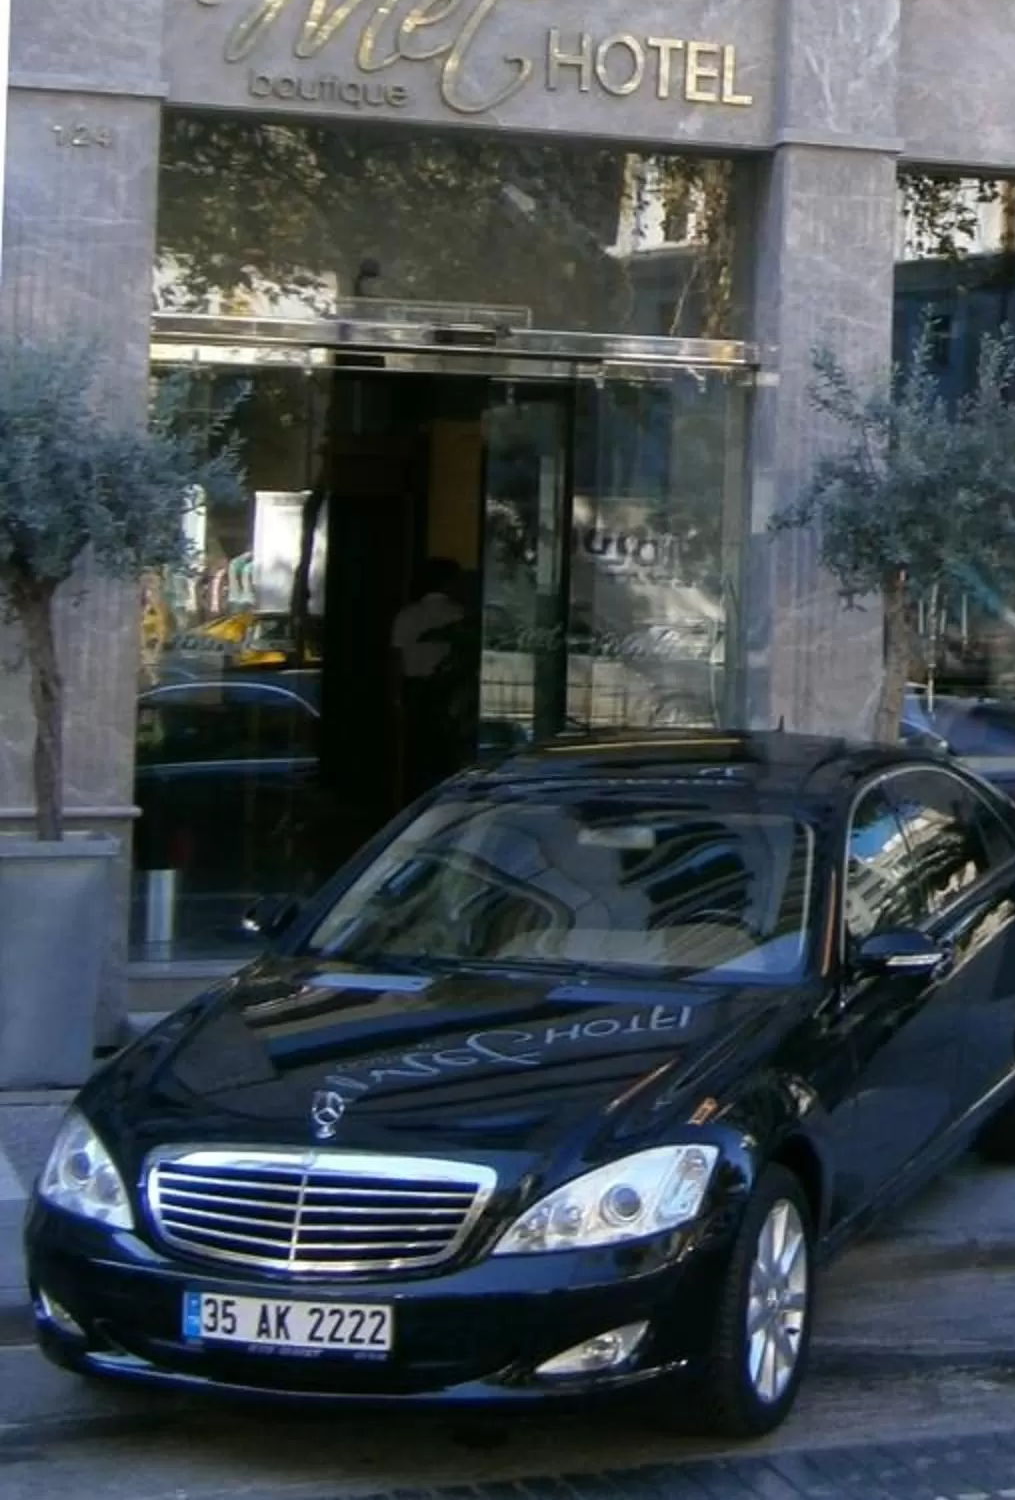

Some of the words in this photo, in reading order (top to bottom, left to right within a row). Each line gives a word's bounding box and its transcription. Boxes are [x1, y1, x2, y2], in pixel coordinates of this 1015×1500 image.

[246, 66, 409, 109] boutique
[544, 24, 754, 106] HOTEL
[203, 1297, 238, 1336] 35
[255, 1303, 291, 1341] AK
[307, 1307, 387, 1345] 2222
